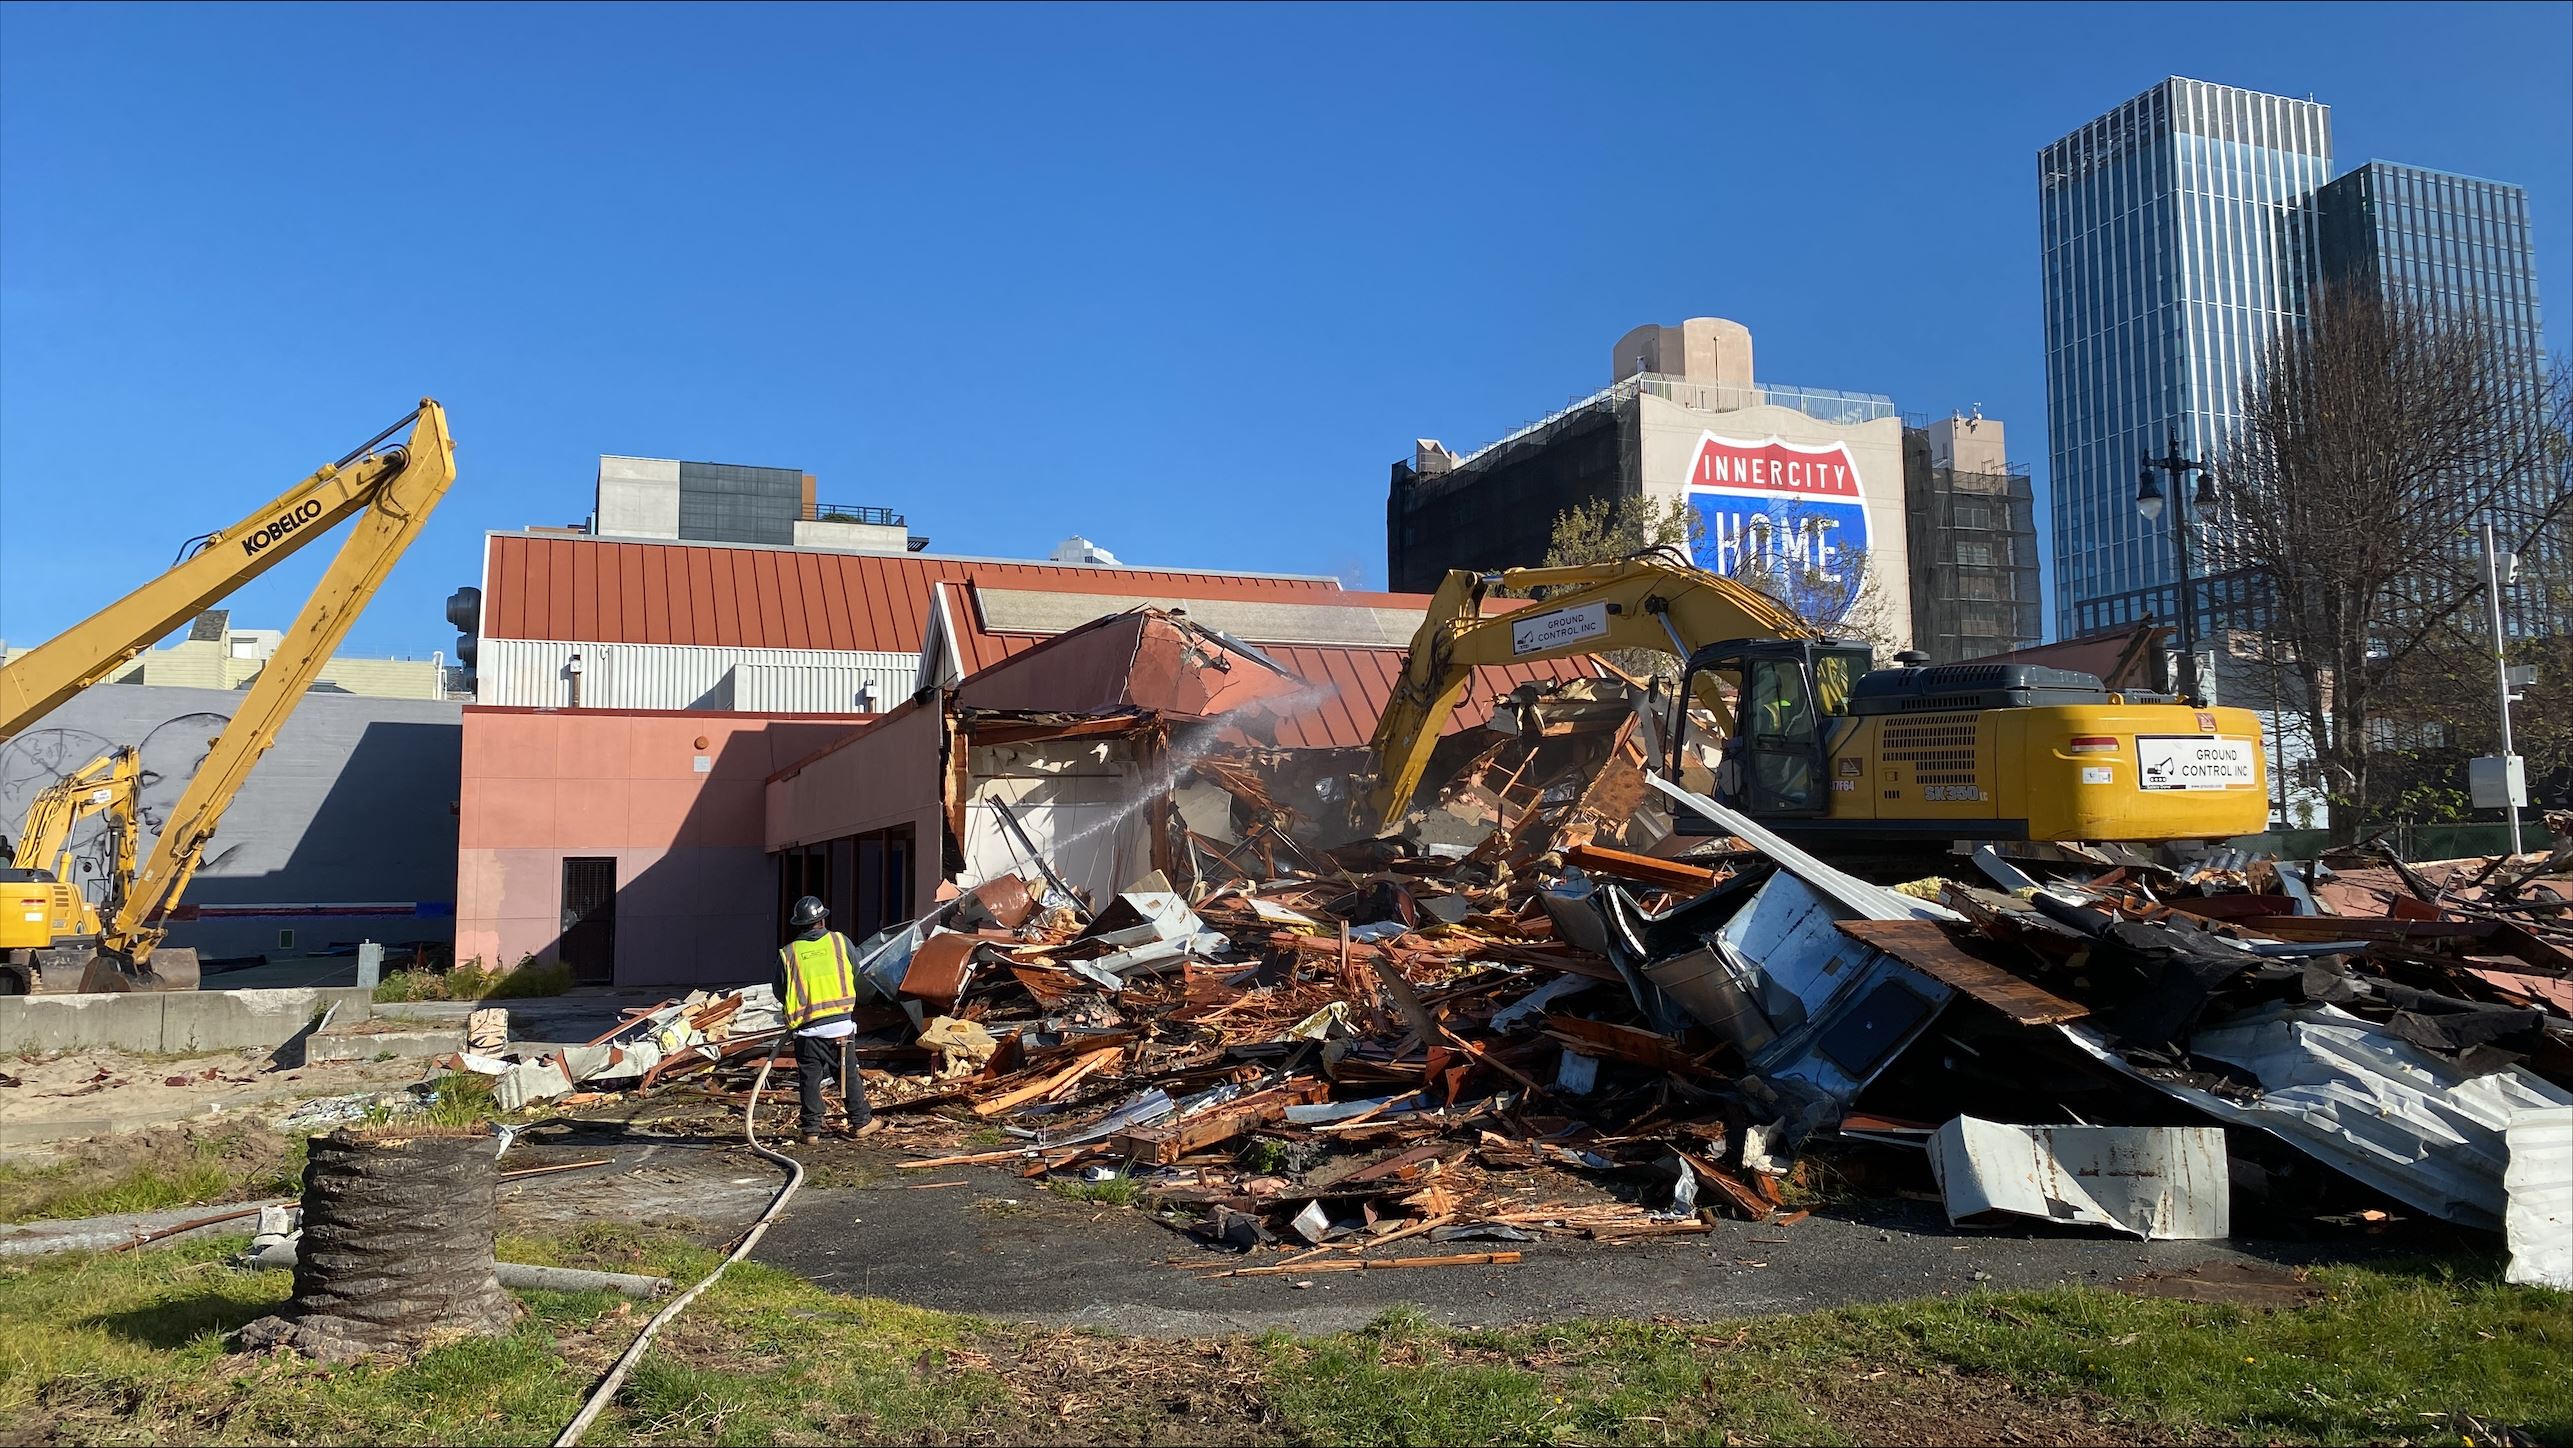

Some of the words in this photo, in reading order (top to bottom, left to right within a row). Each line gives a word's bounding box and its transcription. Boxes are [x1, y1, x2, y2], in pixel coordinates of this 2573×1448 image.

[1704, 454, 1846, 490] INNERCITY
[241, 499, 322, 557] KOBELCO
[1716, 511, 1842, 583] HOME
[1547, 614, 1585, 629] GROUND
[1538, 627, 1579, 642] CONTROL
[1581, 622, 1597, 633] INC
[2196, 749, 2238, 761] GROUND
[2181, 765, 2232, 777] CONTROL
[2234, 765, 2248, 777] INC
